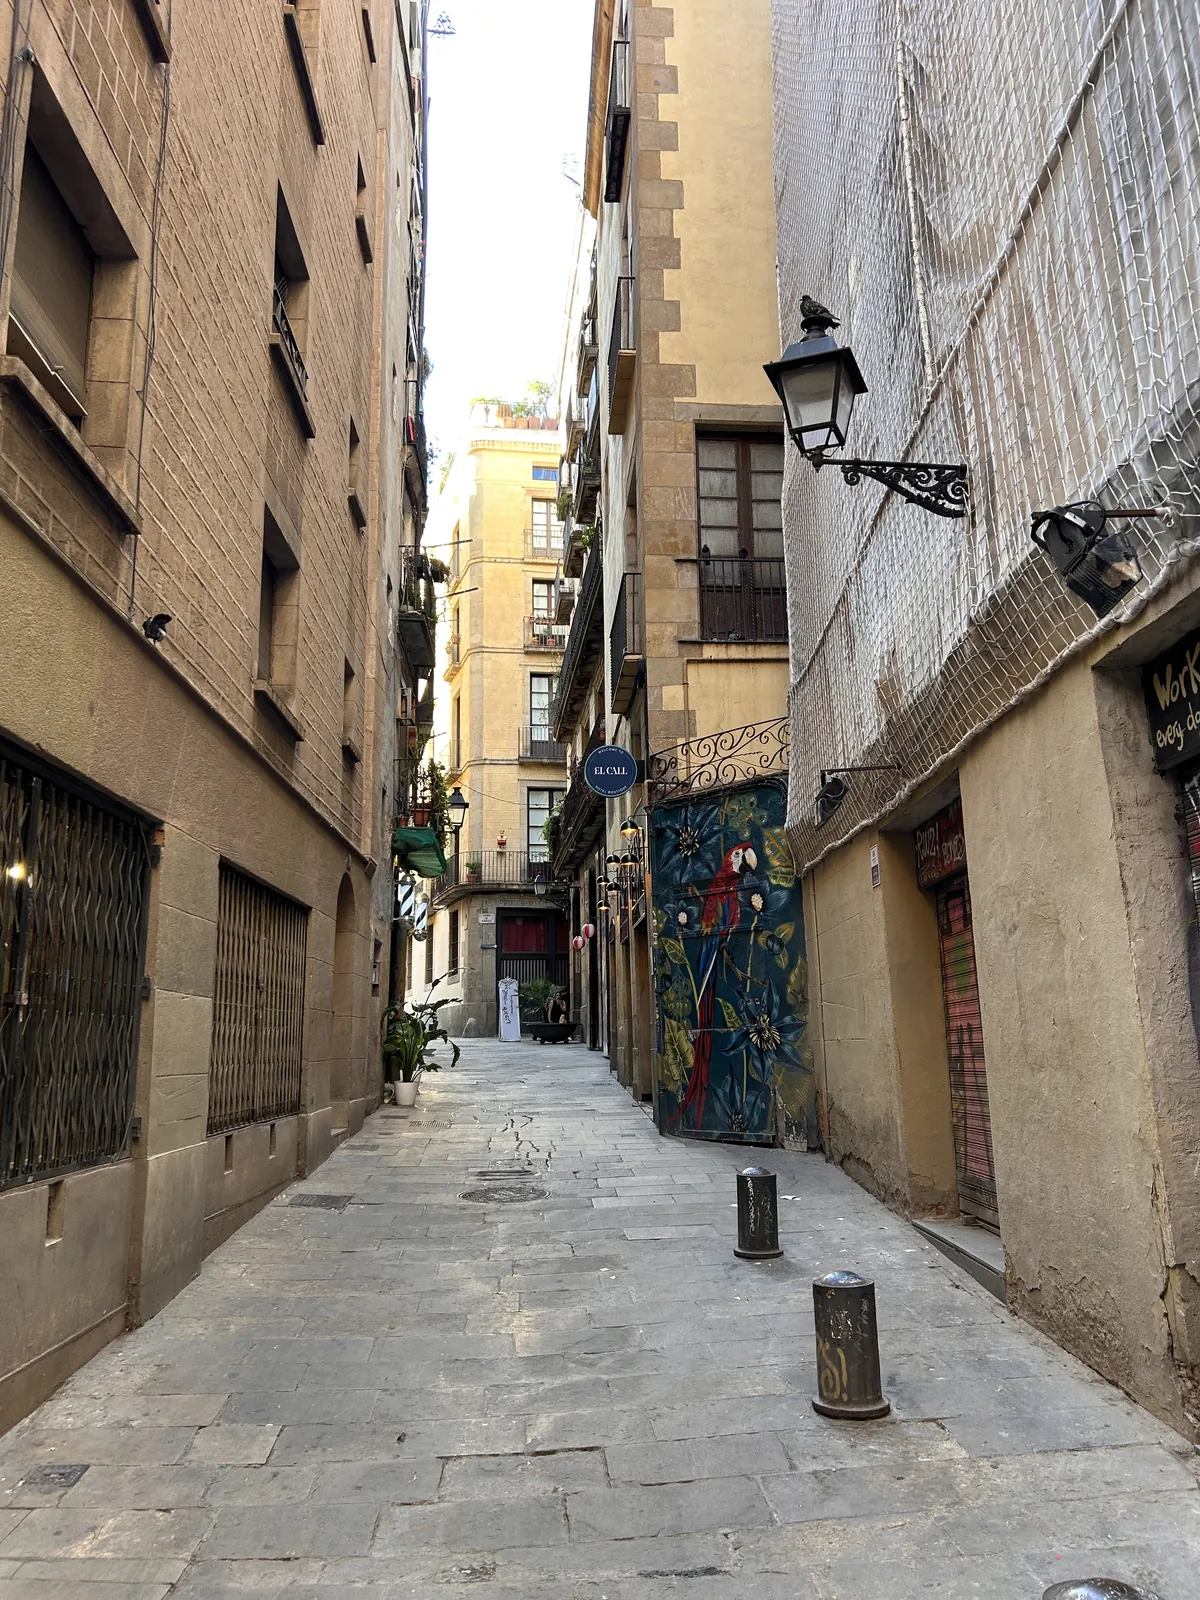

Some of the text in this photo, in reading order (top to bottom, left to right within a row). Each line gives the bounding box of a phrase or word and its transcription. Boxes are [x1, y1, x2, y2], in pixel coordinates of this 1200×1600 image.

[1156, 720, 1186, 751] every
[594, 766, 628, 775] EL CALL
[595, 785, 627, 794] HOTEL BOUTIQUE
